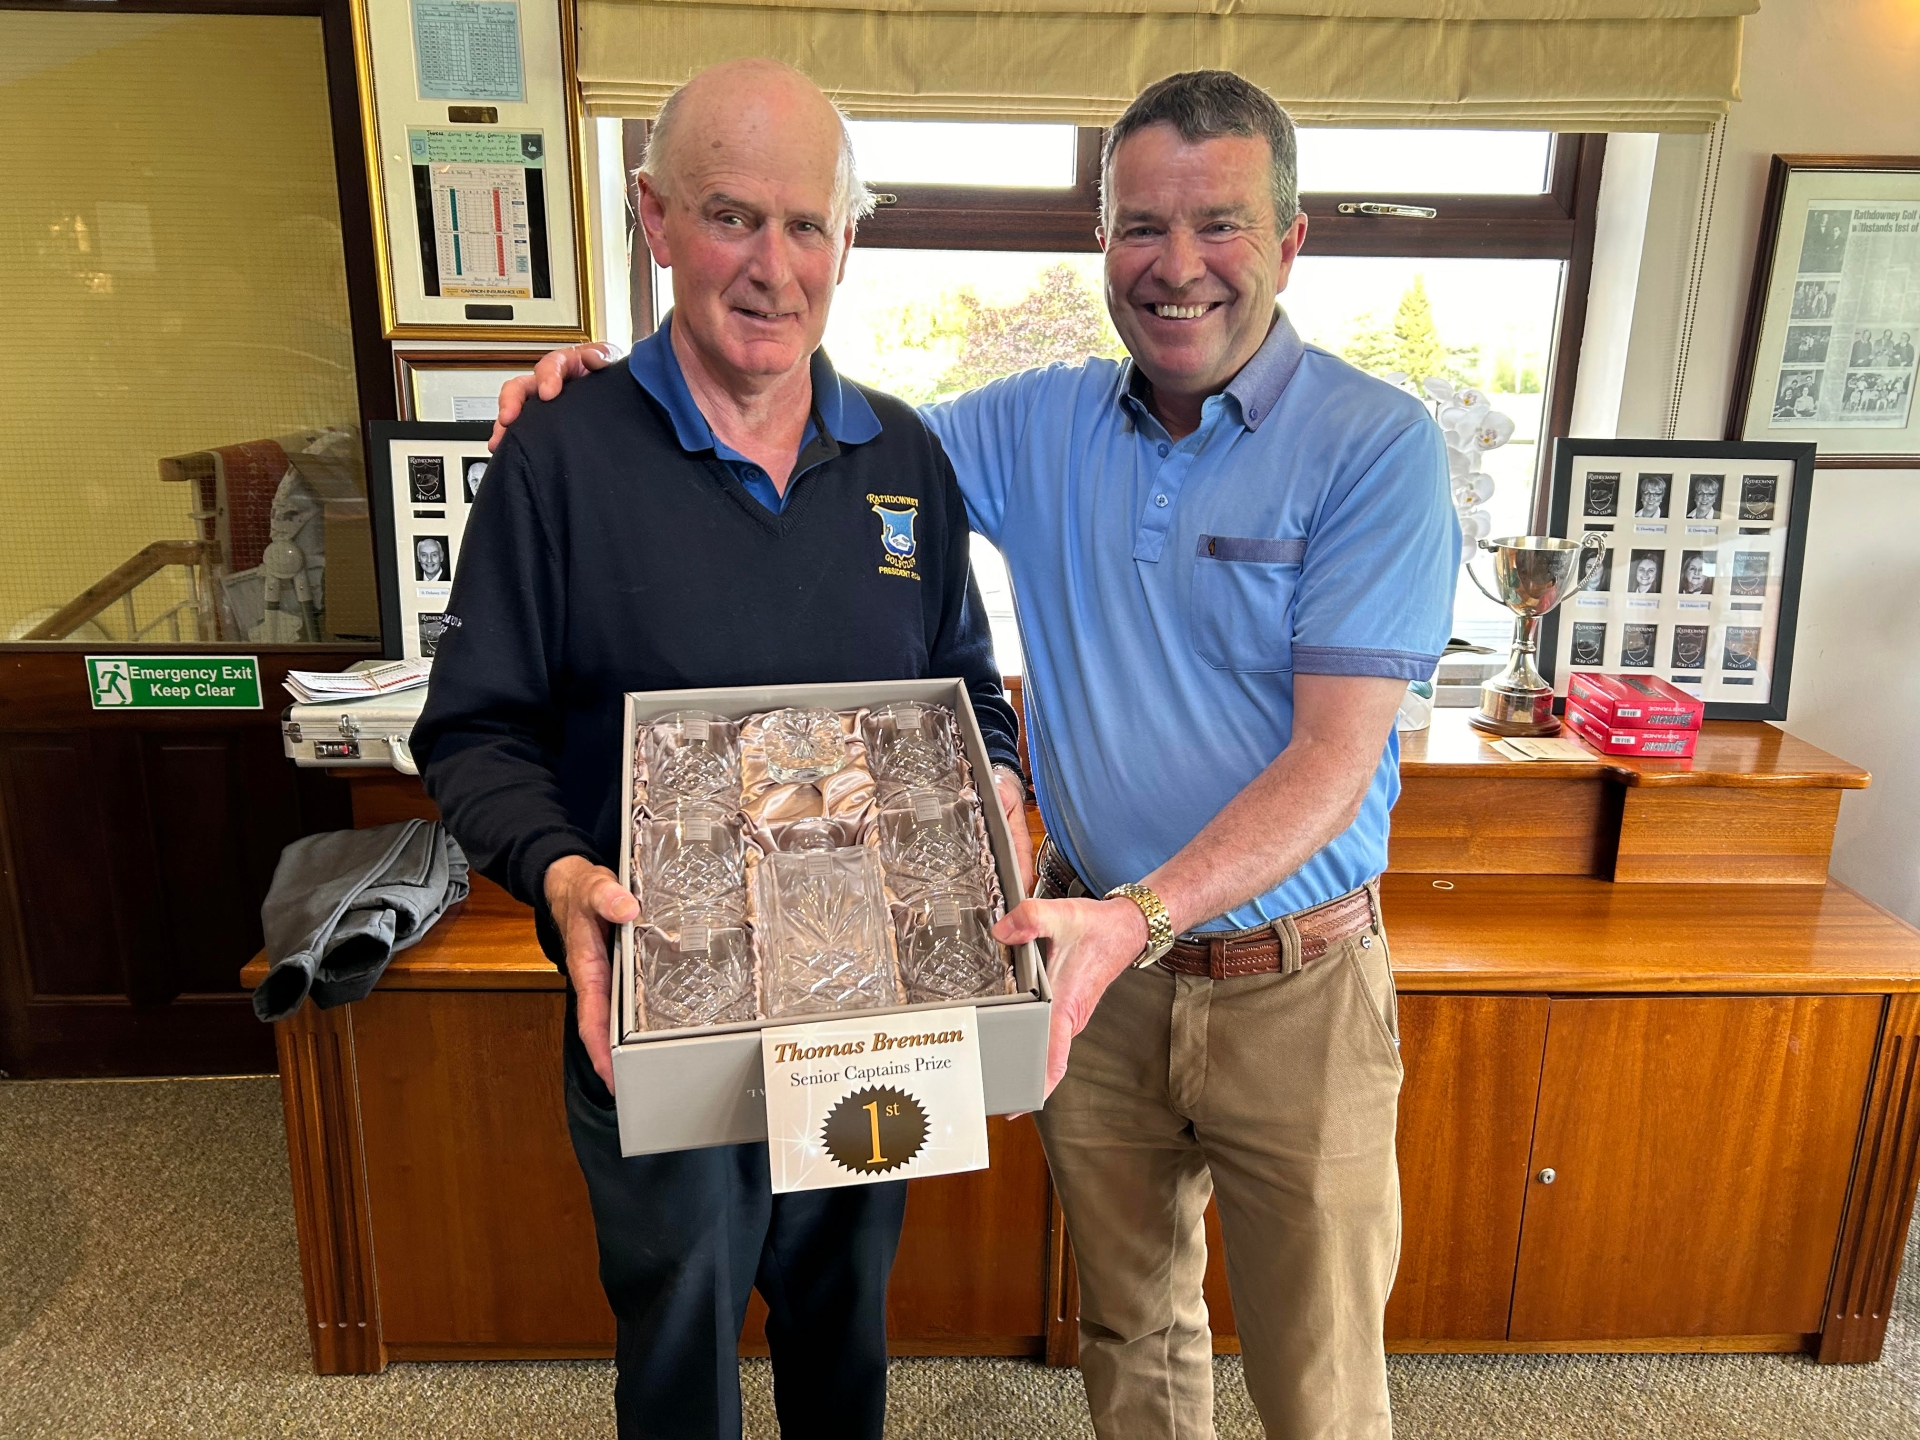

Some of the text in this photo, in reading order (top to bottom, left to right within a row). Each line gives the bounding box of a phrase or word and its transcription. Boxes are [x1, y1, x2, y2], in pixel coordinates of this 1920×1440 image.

[1854, 210, 1917, 221] Rathdowney Golf
[1852, 222, 1919, 232] wthstands test of
[866, 494, 918, 507] RATHDOWNEY
[879, 566, 910, 578] PRESIDENT
[130, 666, 252, 682] Emergency Exit
[151, 684, 236, 699] Keep Clear
[775, 1029, 964, 1063] Thomas Brennan
[790, 1056, 952, 1087] Senior Captains Prize
[863, 1100, 900, 1164] 1st
